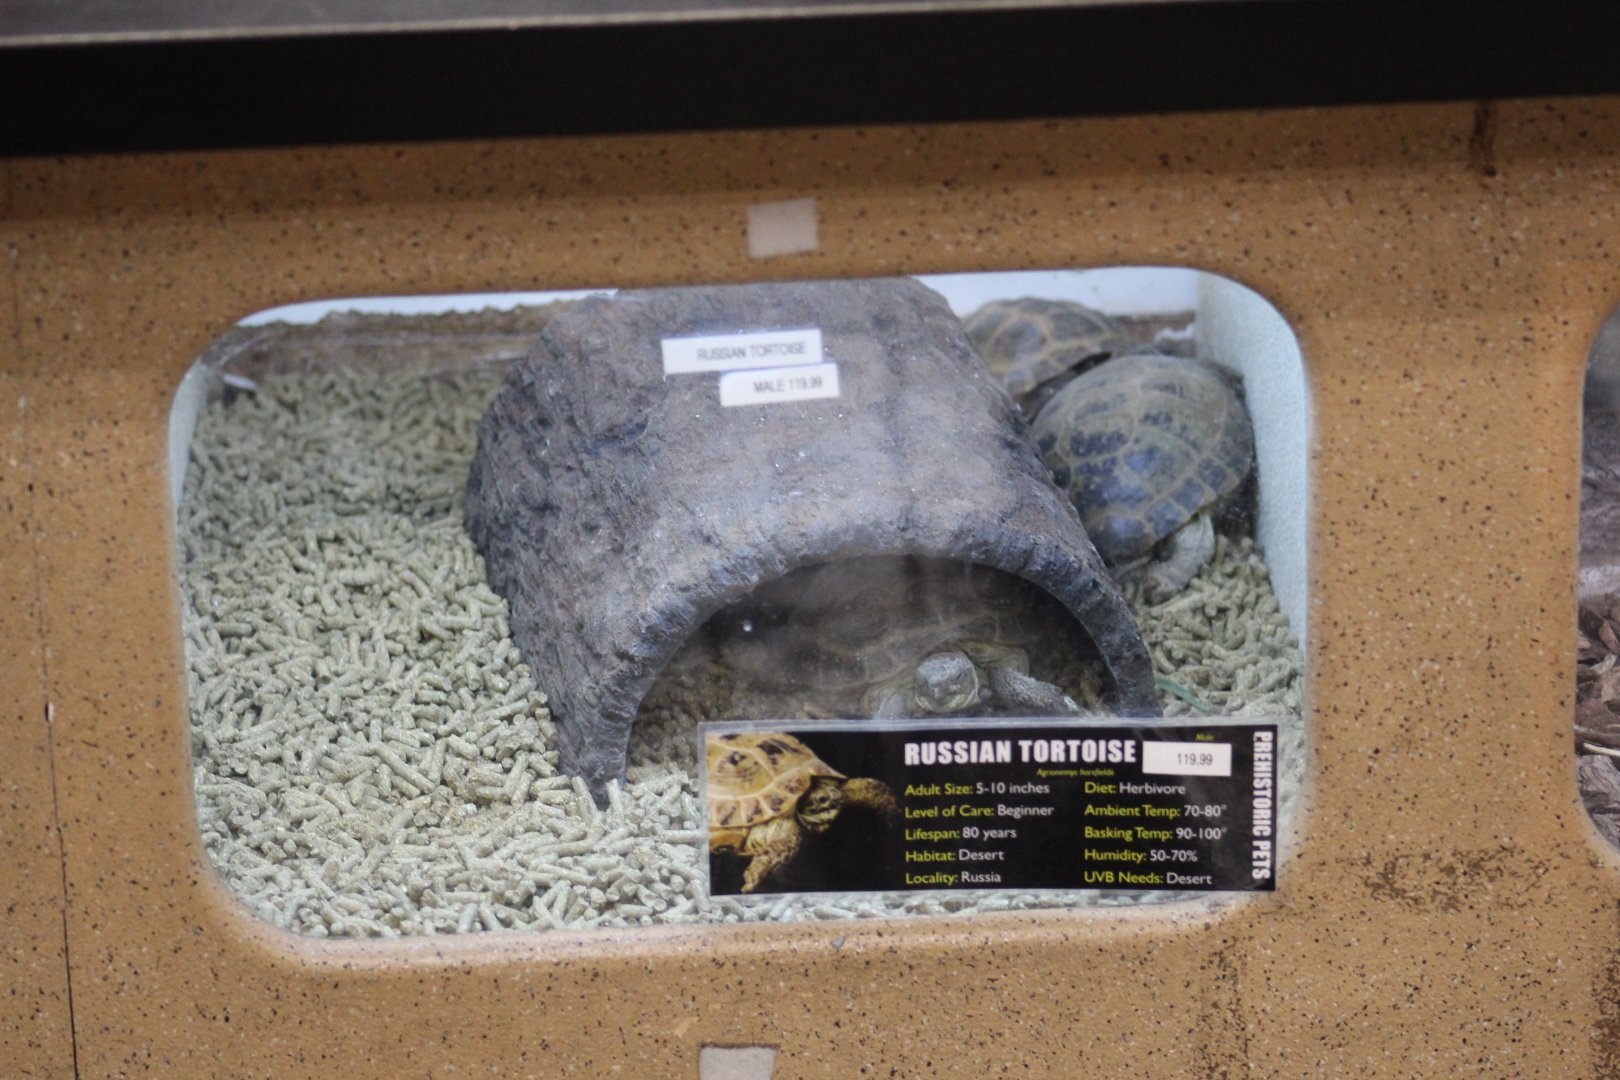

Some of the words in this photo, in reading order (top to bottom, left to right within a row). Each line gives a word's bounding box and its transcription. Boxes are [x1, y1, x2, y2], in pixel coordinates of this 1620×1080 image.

[696, 347, 746, 360] RUSSIAN
[749, 342, 806, 357] TORTOISE
[753, 379, 784, 392] MALE
[904, 740, 1012, 766] RUSSIAN
[1018, 739, 1137, 763] TORTOISE
[1176, 752, 1214, 766] 119.99
[904, 784, 941, 796] Adult
[944, 782, 974, 795] Size:
[976, 782, 1006, 794] 5-10
[1009, 781, 1050, 794] inches
[1084, 781, 1117, 794] Diet:
[1119, 781, 1186, 795] Herbivore
[1252, 731, 1274, 837] PREHISTORIC
[904, 806, 938, 818] Level
[942, 805, 957, 817] of
[959, 804, 994, 817] Care:
[997, 804, 1055, 819] Beginner
[1084, 803, 1141, 817] Ambient
[1141, 804, 1180, 820] Temp:
[1183, 803, 1227, 817] 70-80°
[904, 828, 960, 842] Lifespan:
[962, 826, 979, 839] 80
[982, 828, 1017, 841] years
[1084, 826, 1133, 841] Basking
[1134, 826, 1173, 842] Temp:
[1175, 826, 1228, 840] 90-100°
[905, 850, 956, 862] Habitat:
[958, 849, 1005, 861] Desert
[1084, 848, 1147, 864] Humidity:
[1150, 849, 1198, 862] 50-70%
[1251, 840, 1272, 880] PETS
[905, 871, 958, 886] Locality:
[961, 871, 1002, 883] Russia
[1084, 871, 1115, 883] UVB
[1118, 871, 1164, 884] Needs:
[1166, 872, 1212, 884] Desert
